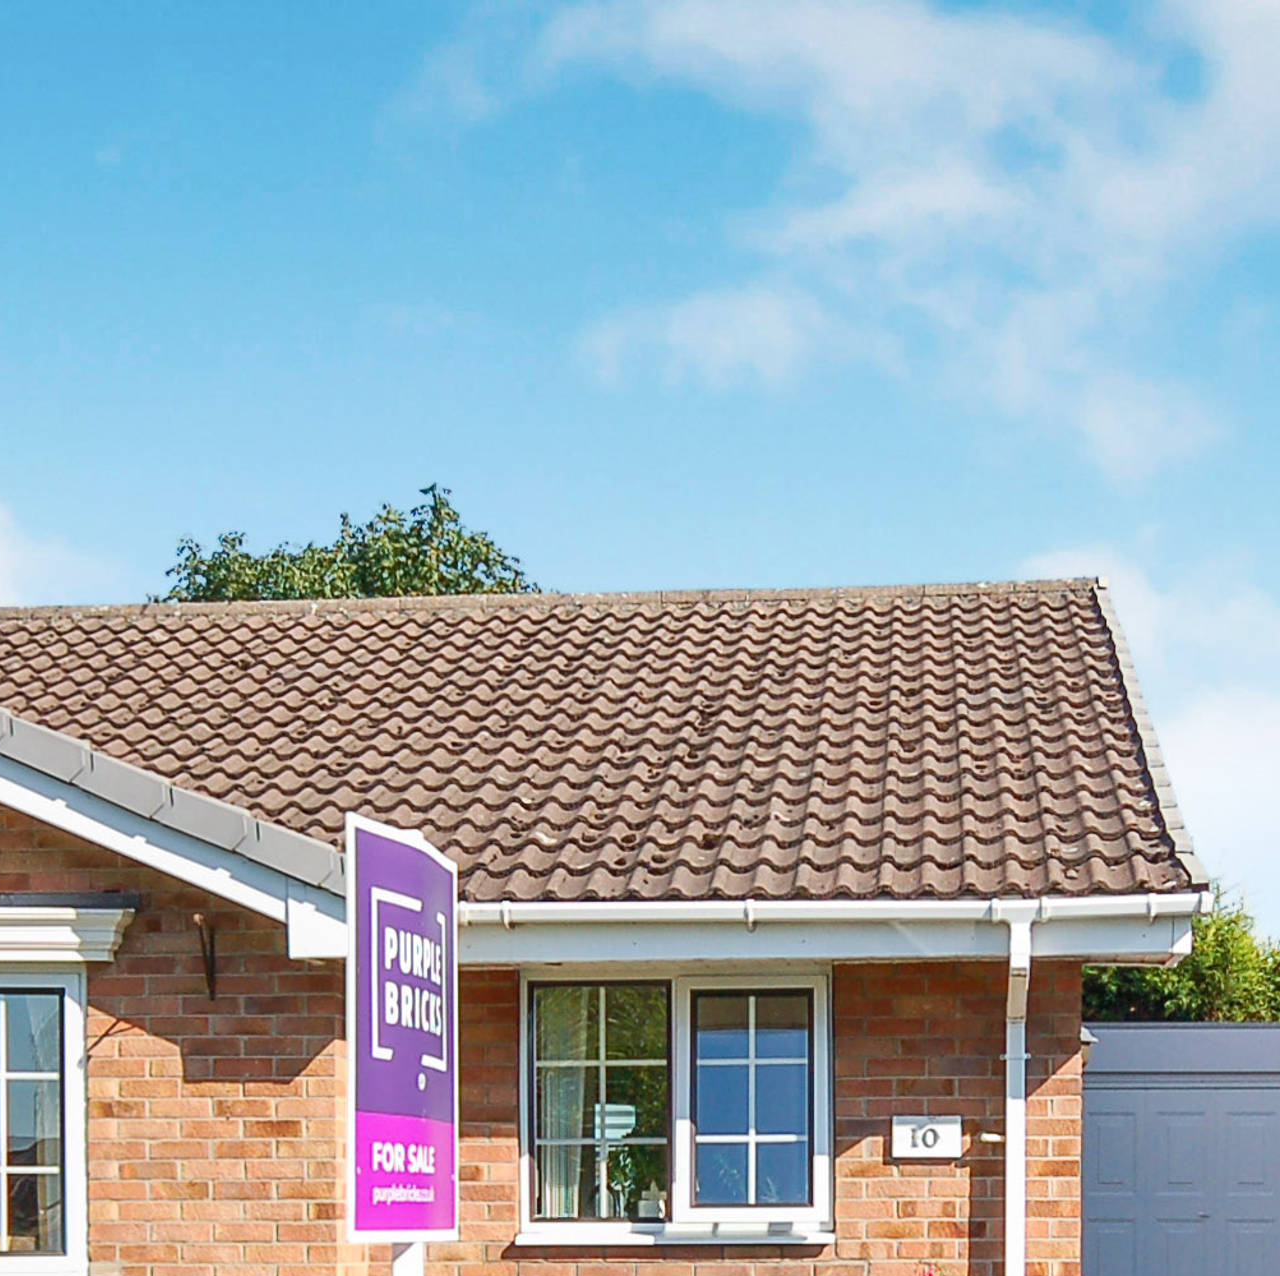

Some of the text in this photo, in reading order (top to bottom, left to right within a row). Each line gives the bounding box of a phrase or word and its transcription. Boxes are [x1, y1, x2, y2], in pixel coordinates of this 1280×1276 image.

[384, 926, 441, 986] PURPLE
[384, 981, 442, 1036] BRICKS
[373, 1142, 436, 1174] FOR SALE
[910, 1128, 940, 1149] 10
